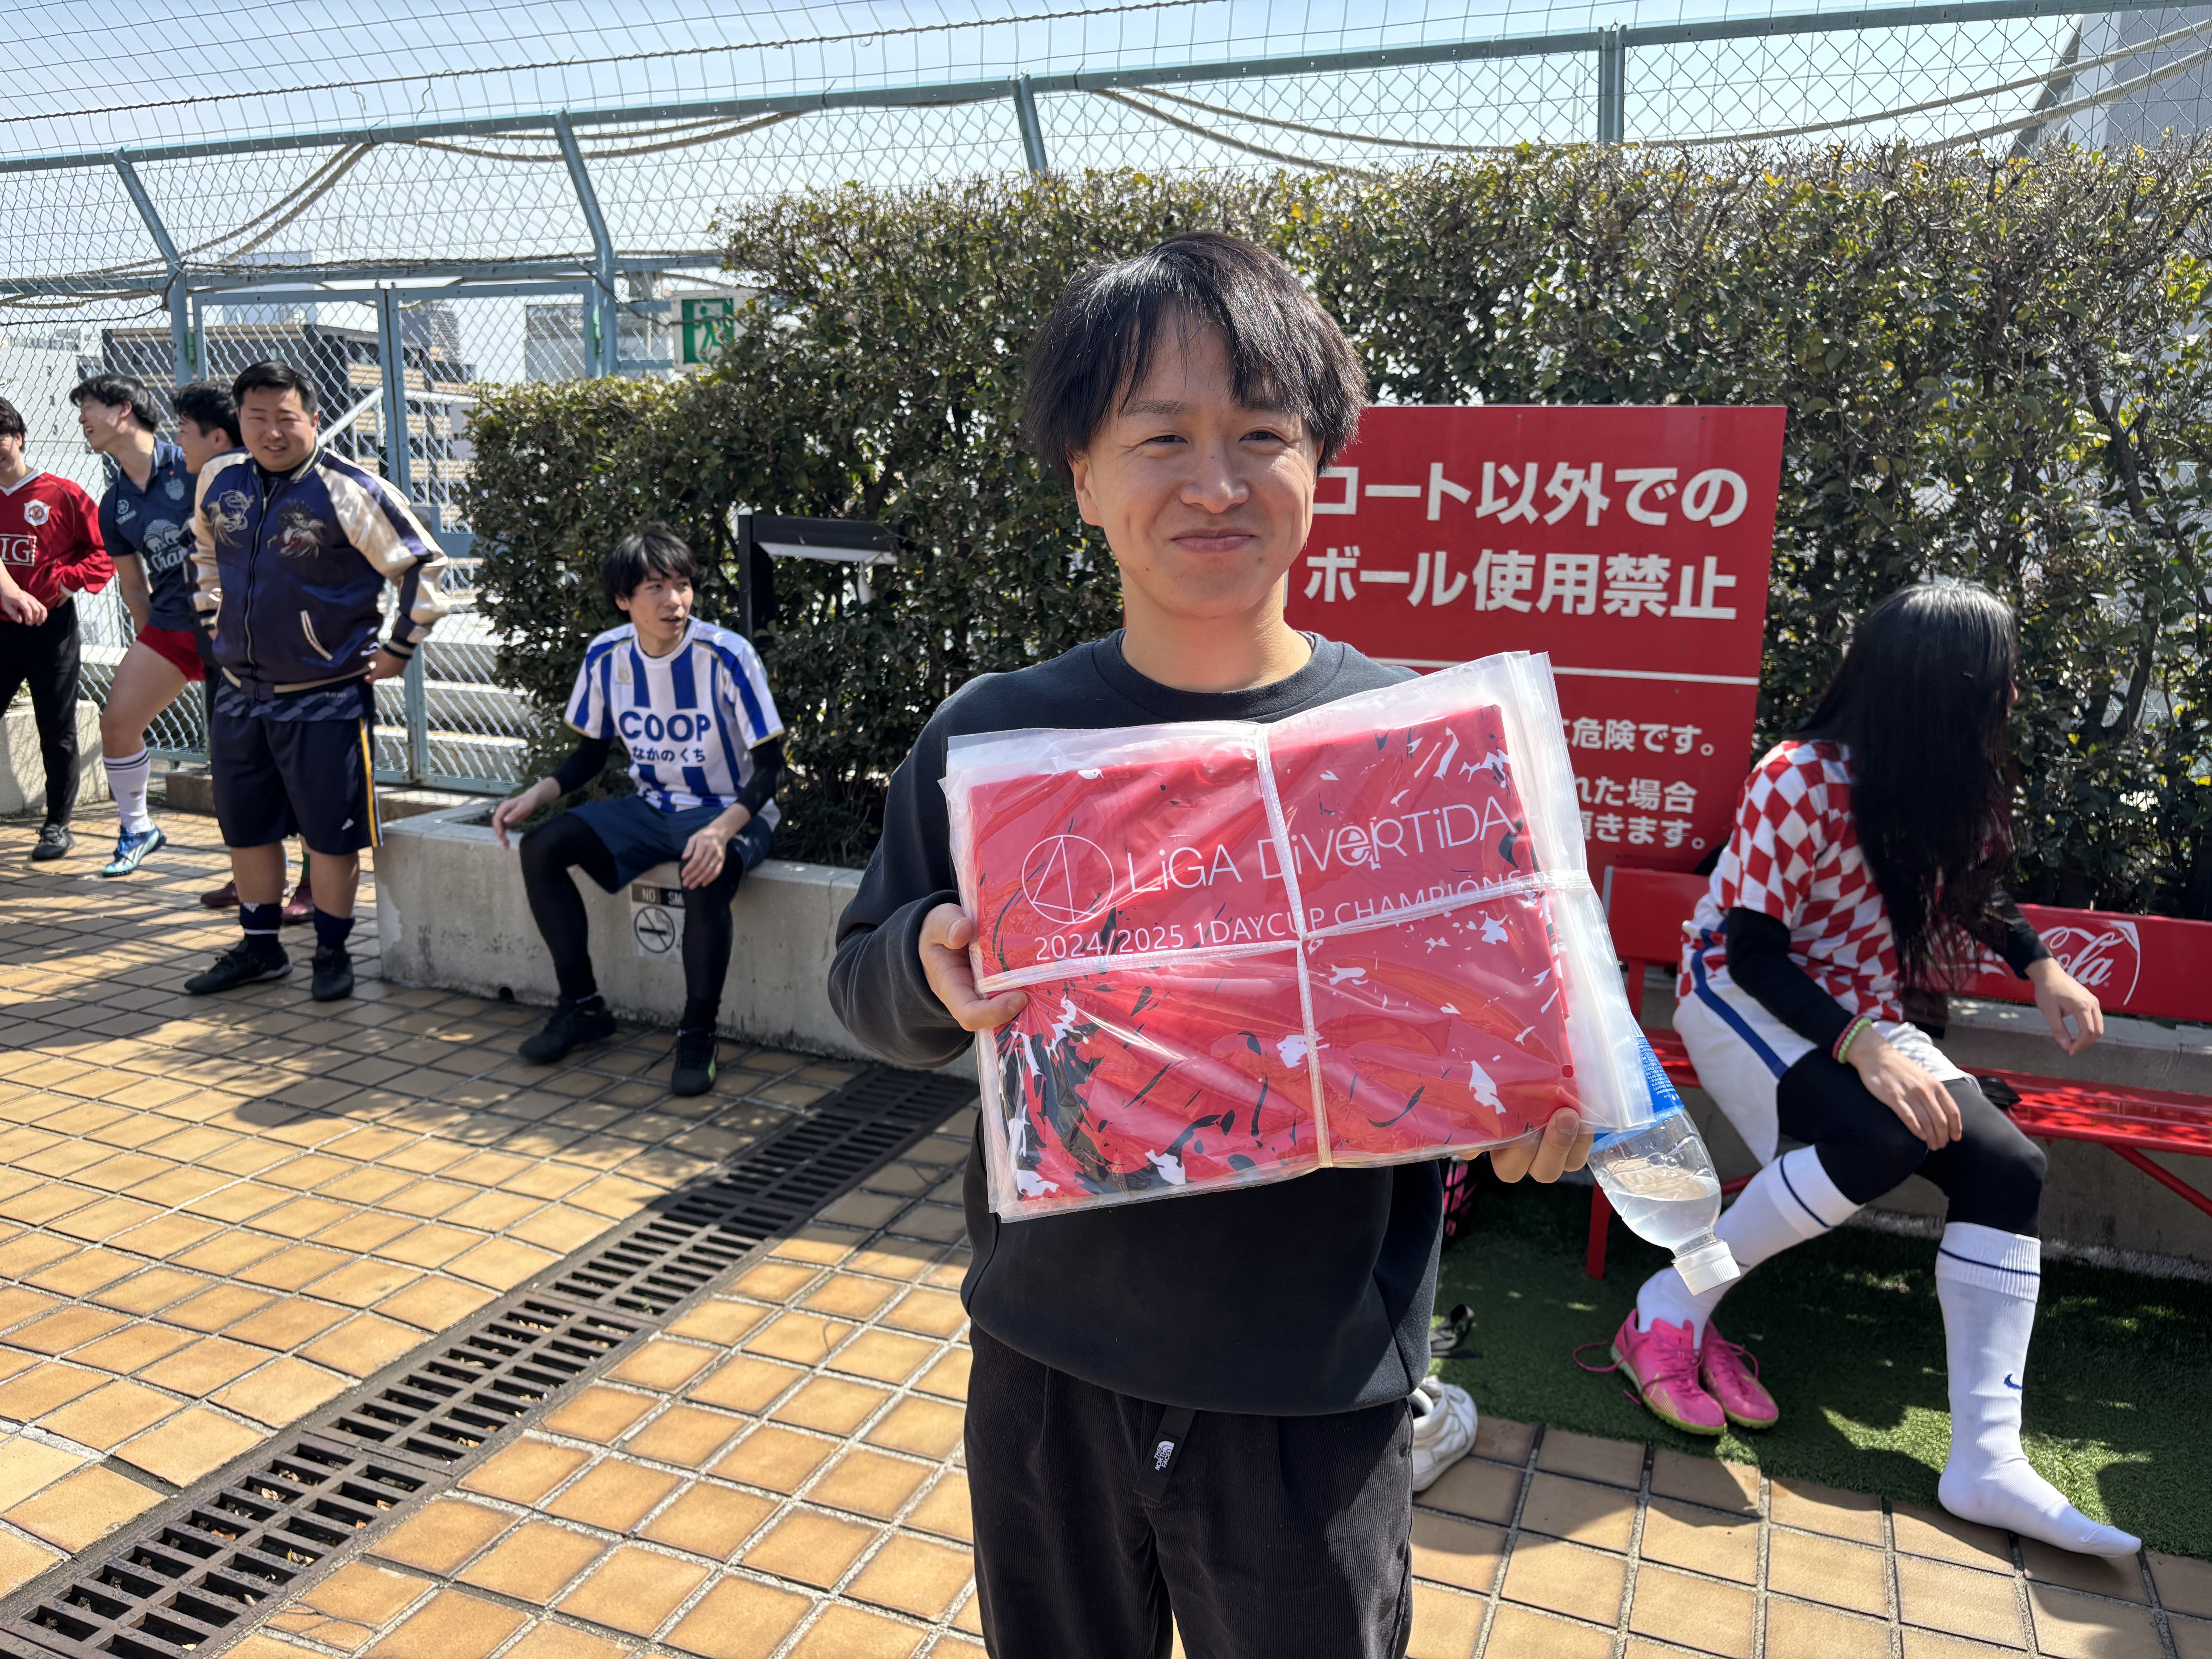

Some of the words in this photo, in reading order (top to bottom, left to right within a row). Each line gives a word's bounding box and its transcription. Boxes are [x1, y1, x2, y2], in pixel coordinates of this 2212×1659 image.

[1312, 462, 1748, 527] コート以外での
[1304, 546, 1737, 620] ボール使用禁止
[618, 711, 711, 742] COOP
[632, 746, 706, 763] なかのくち
[642, 888, 656, 903] NO
[1034, 924, 1185, 961] 2024/2025
[1154, 1446, 1162, 1459] THE
[1154, 1449, 1166, 1471] NORTH
[1161, 1451, 1172, 1468] FACE
